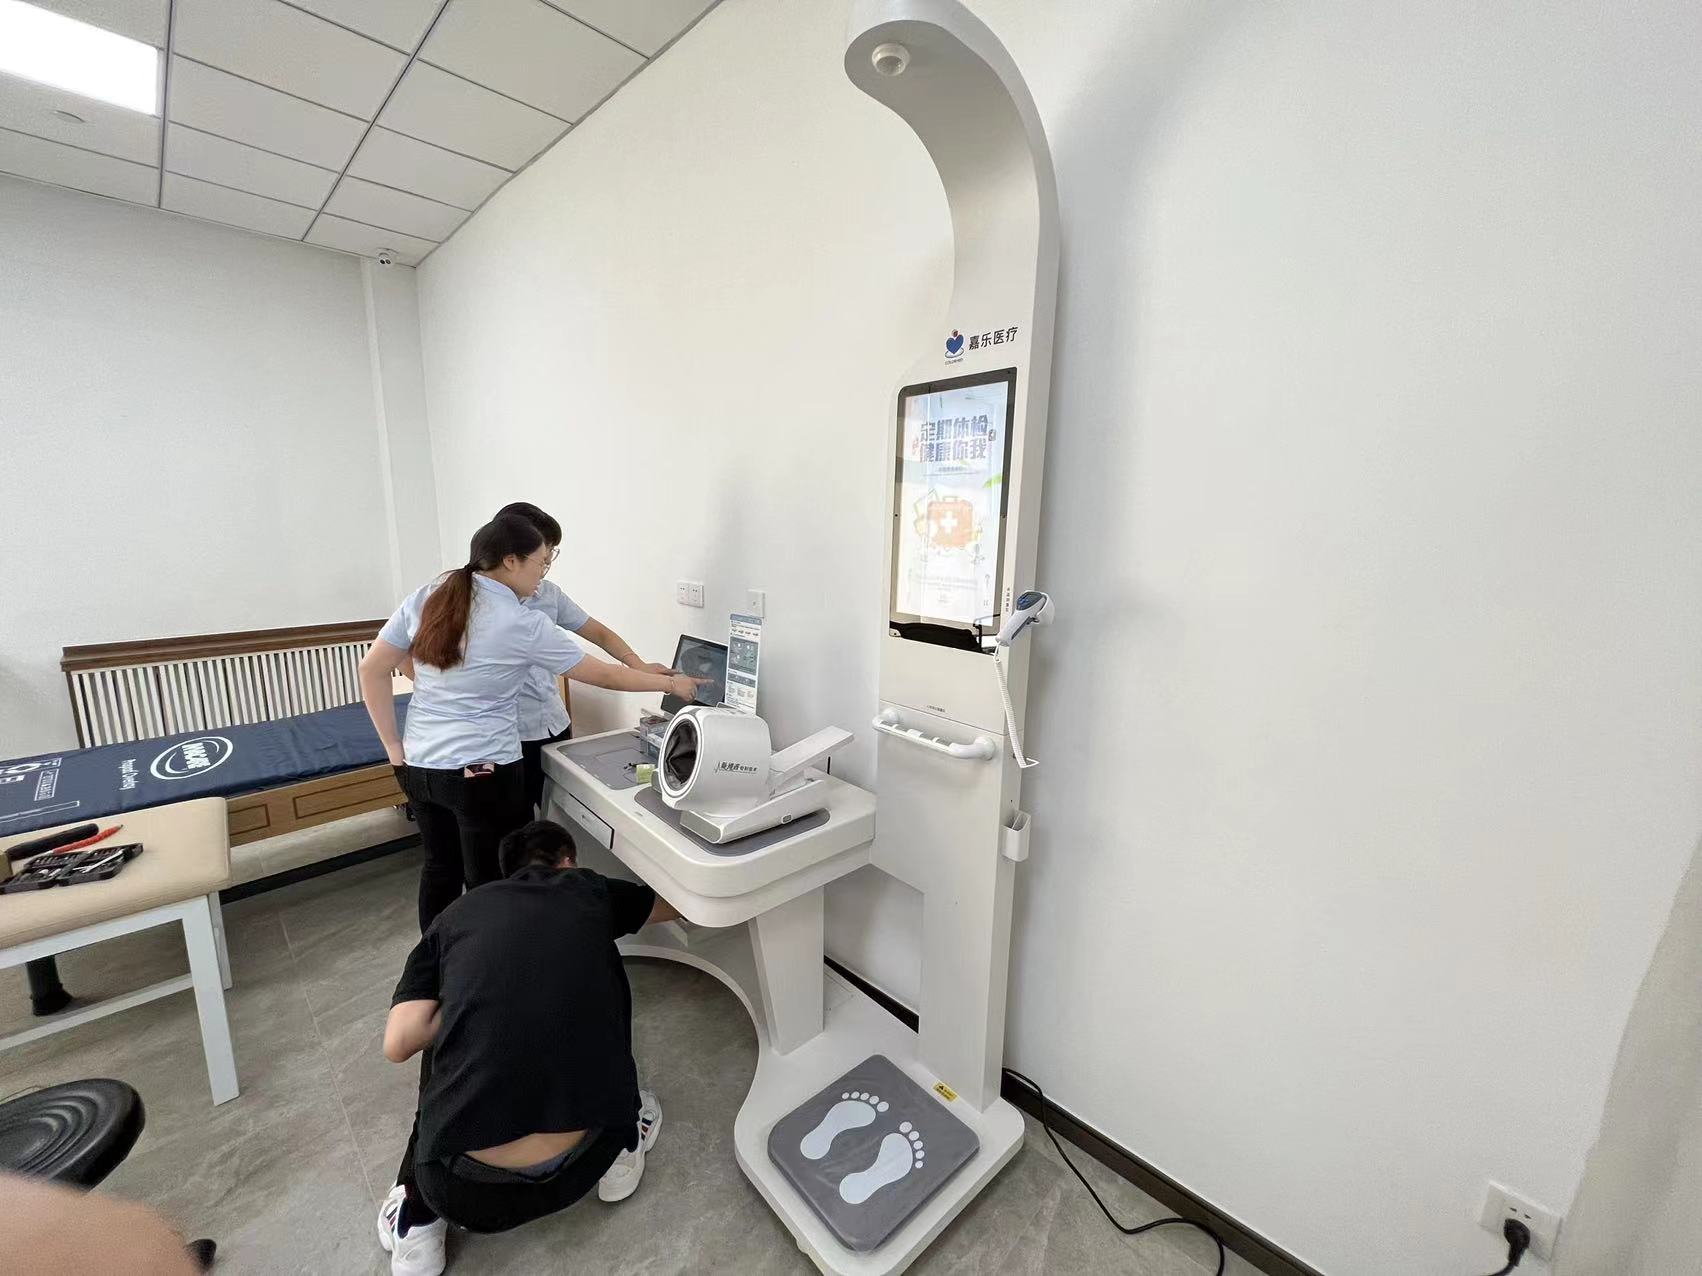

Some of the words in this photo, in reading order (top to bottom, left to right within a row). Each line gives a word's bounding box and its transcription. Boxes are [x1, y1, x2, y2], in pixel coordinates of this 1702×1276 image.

[968, 326, 1018, 350] 嘉乐医疗
[920, 414, 988, 442] 定期体检
[919, 438, 987, 463] 健康你我
